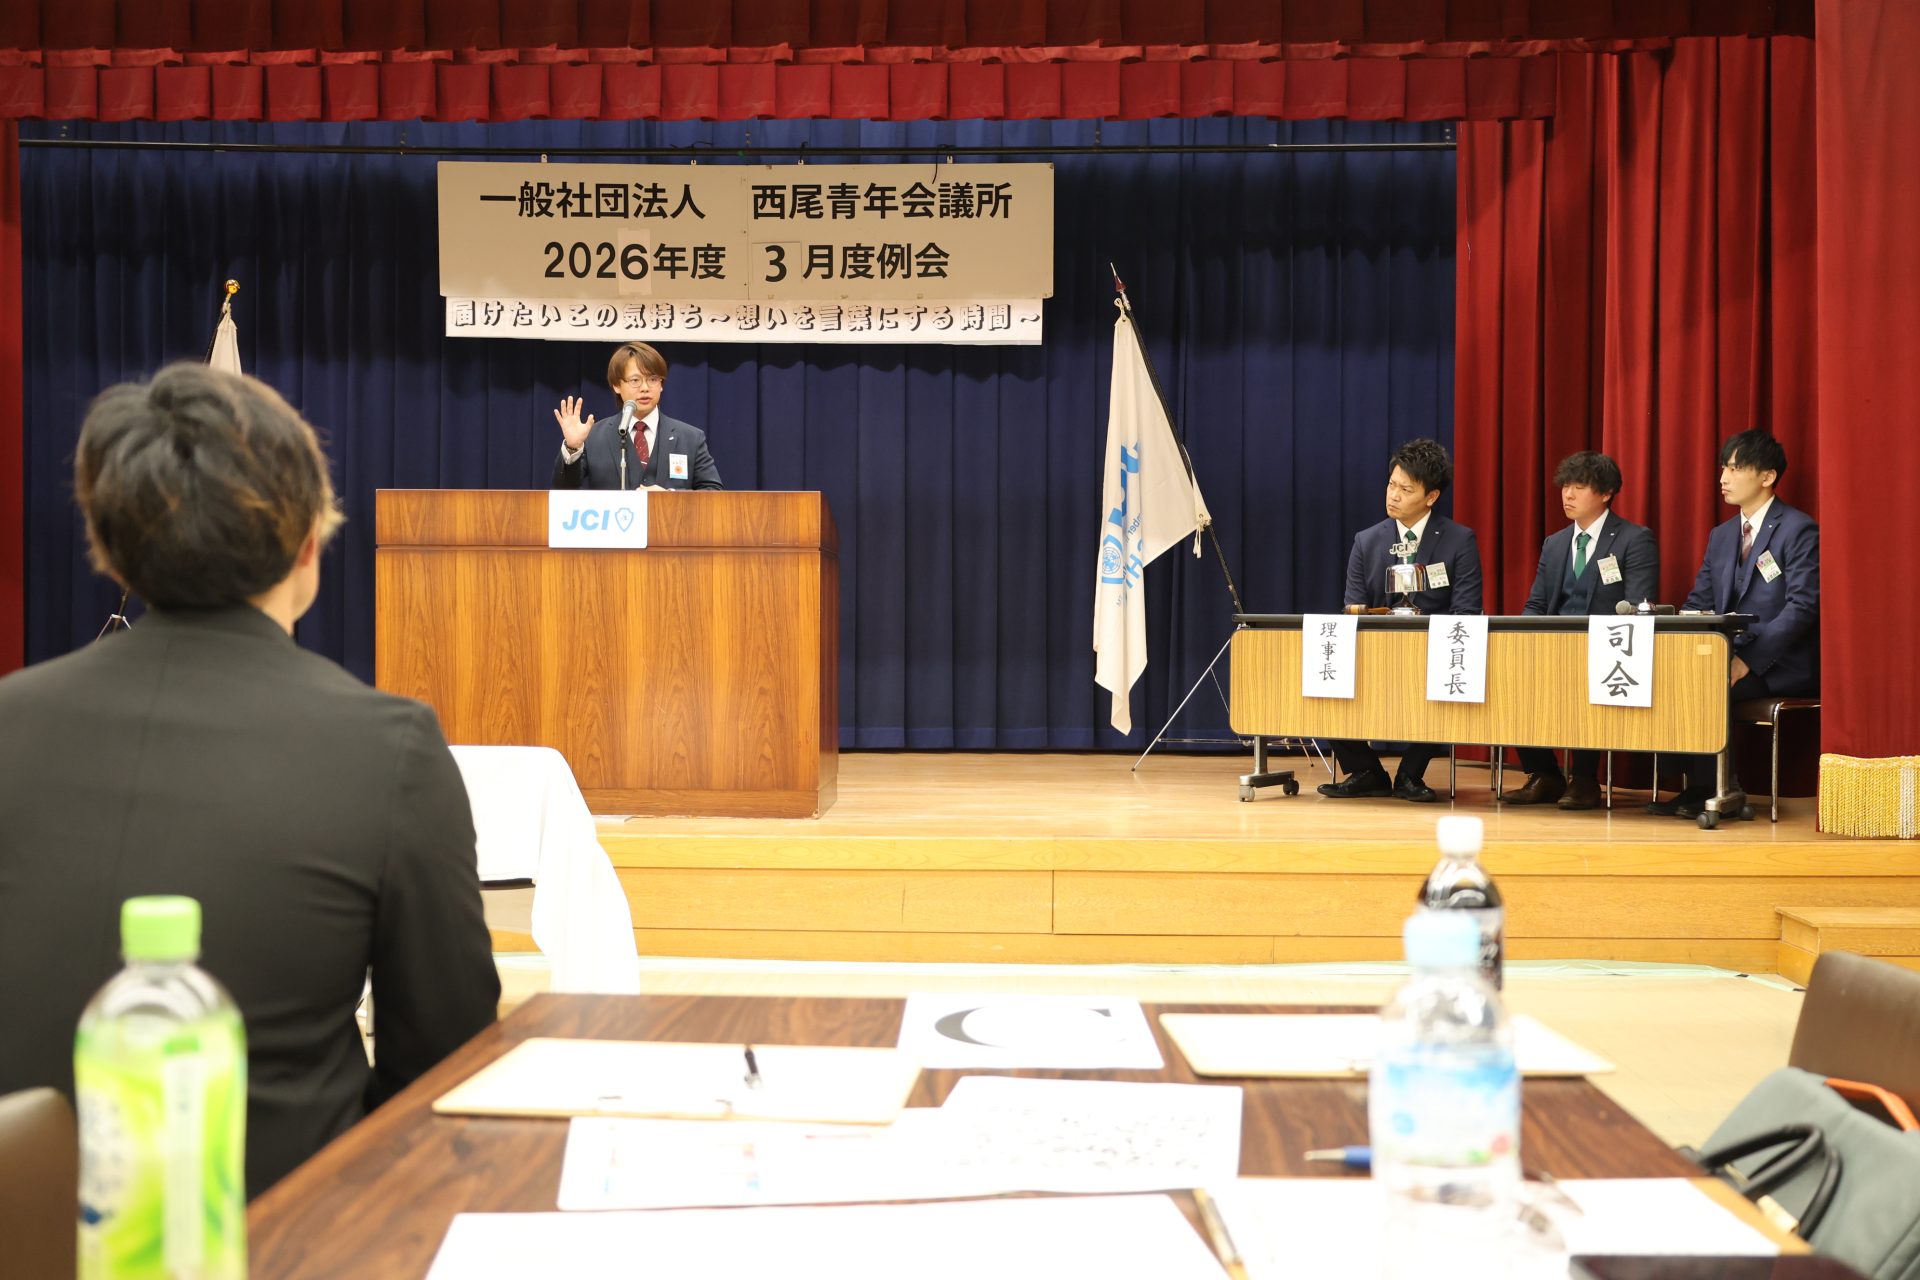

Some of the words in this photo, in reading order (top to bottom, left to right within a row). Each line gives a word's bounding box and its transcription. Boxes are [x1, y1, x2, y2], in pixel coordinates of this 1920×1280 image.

[480, 181, 706, 219] 一般社団法人
[752, 182, 1013, 219] 西尾青年会議所
[544, 241, 726, 280] 2026年度
[562, 509, 610, 531] JCI
[1390, 543, 1408, 554] JCI
[1319, 621, 1337, 681] 理事長
[1443, 621, 1470, 695] 委員長
[1601, 623, 1640, 698] 司会
